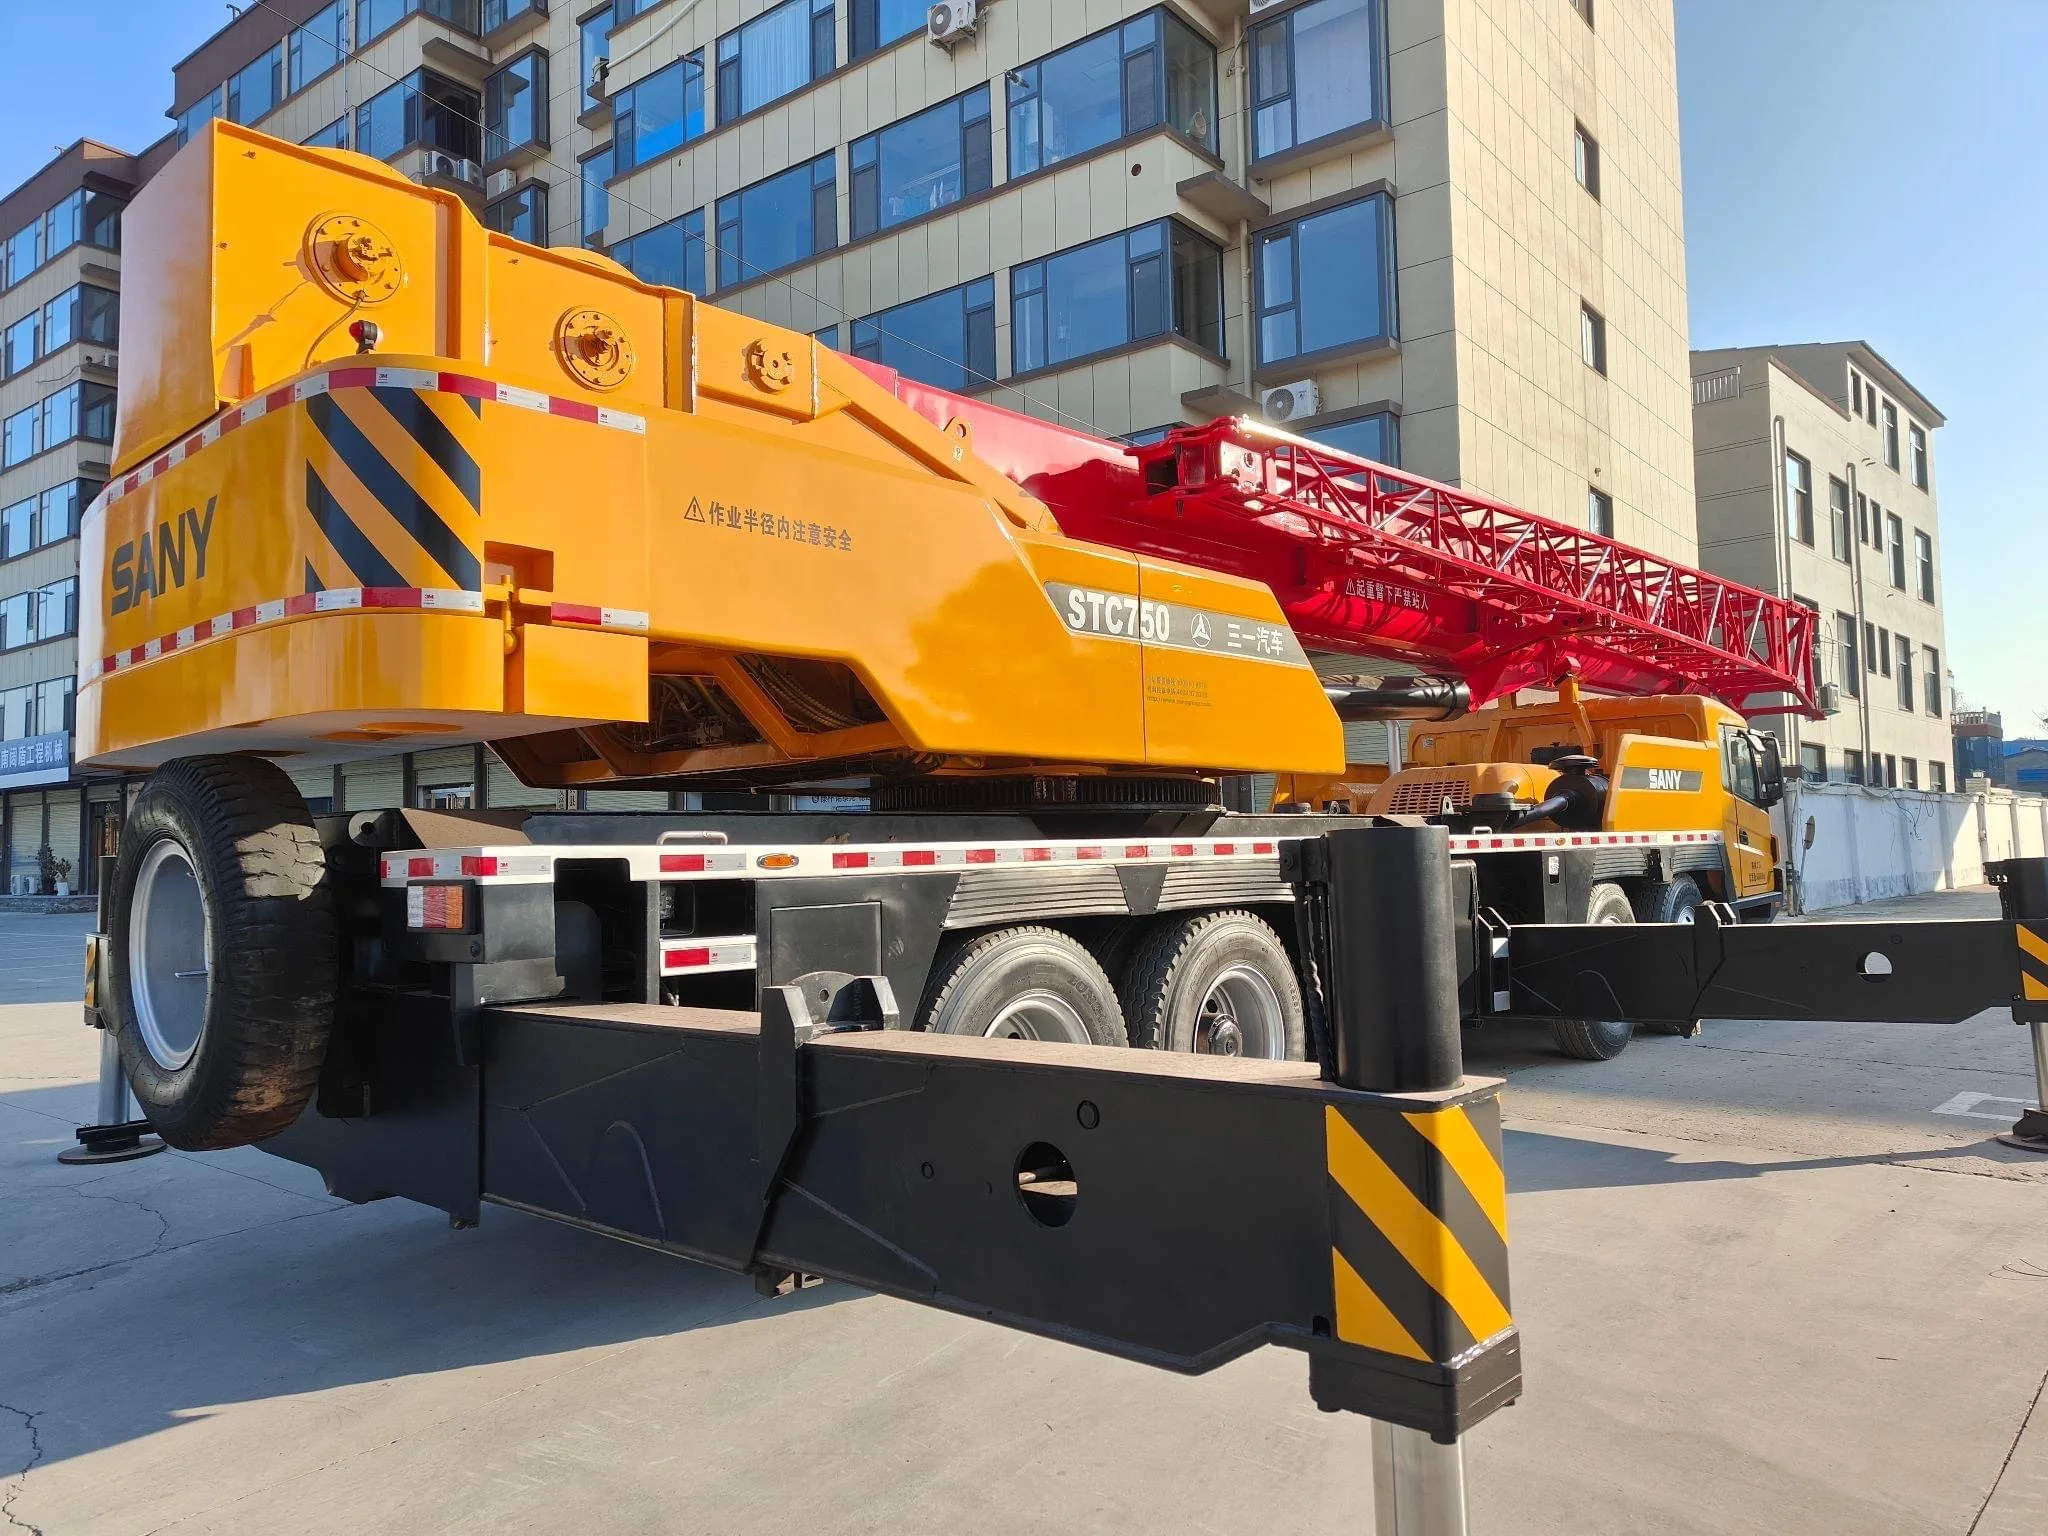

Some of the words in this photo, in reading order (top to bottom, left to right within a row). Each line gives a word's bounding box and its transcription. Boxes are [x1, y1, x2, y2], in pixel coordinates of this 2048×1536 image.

[708, 500, 852, 552] 作业半径内注意安全
[111, 494, 218, 617] SANY
[1355, 577, 1429, 611] 起重臂下严禁站人
[1067, 588, 1170, 642] STC750
[1227, 622, 1284, 656] 三一汽车
[1648, 768, 1682, 790] SANY
